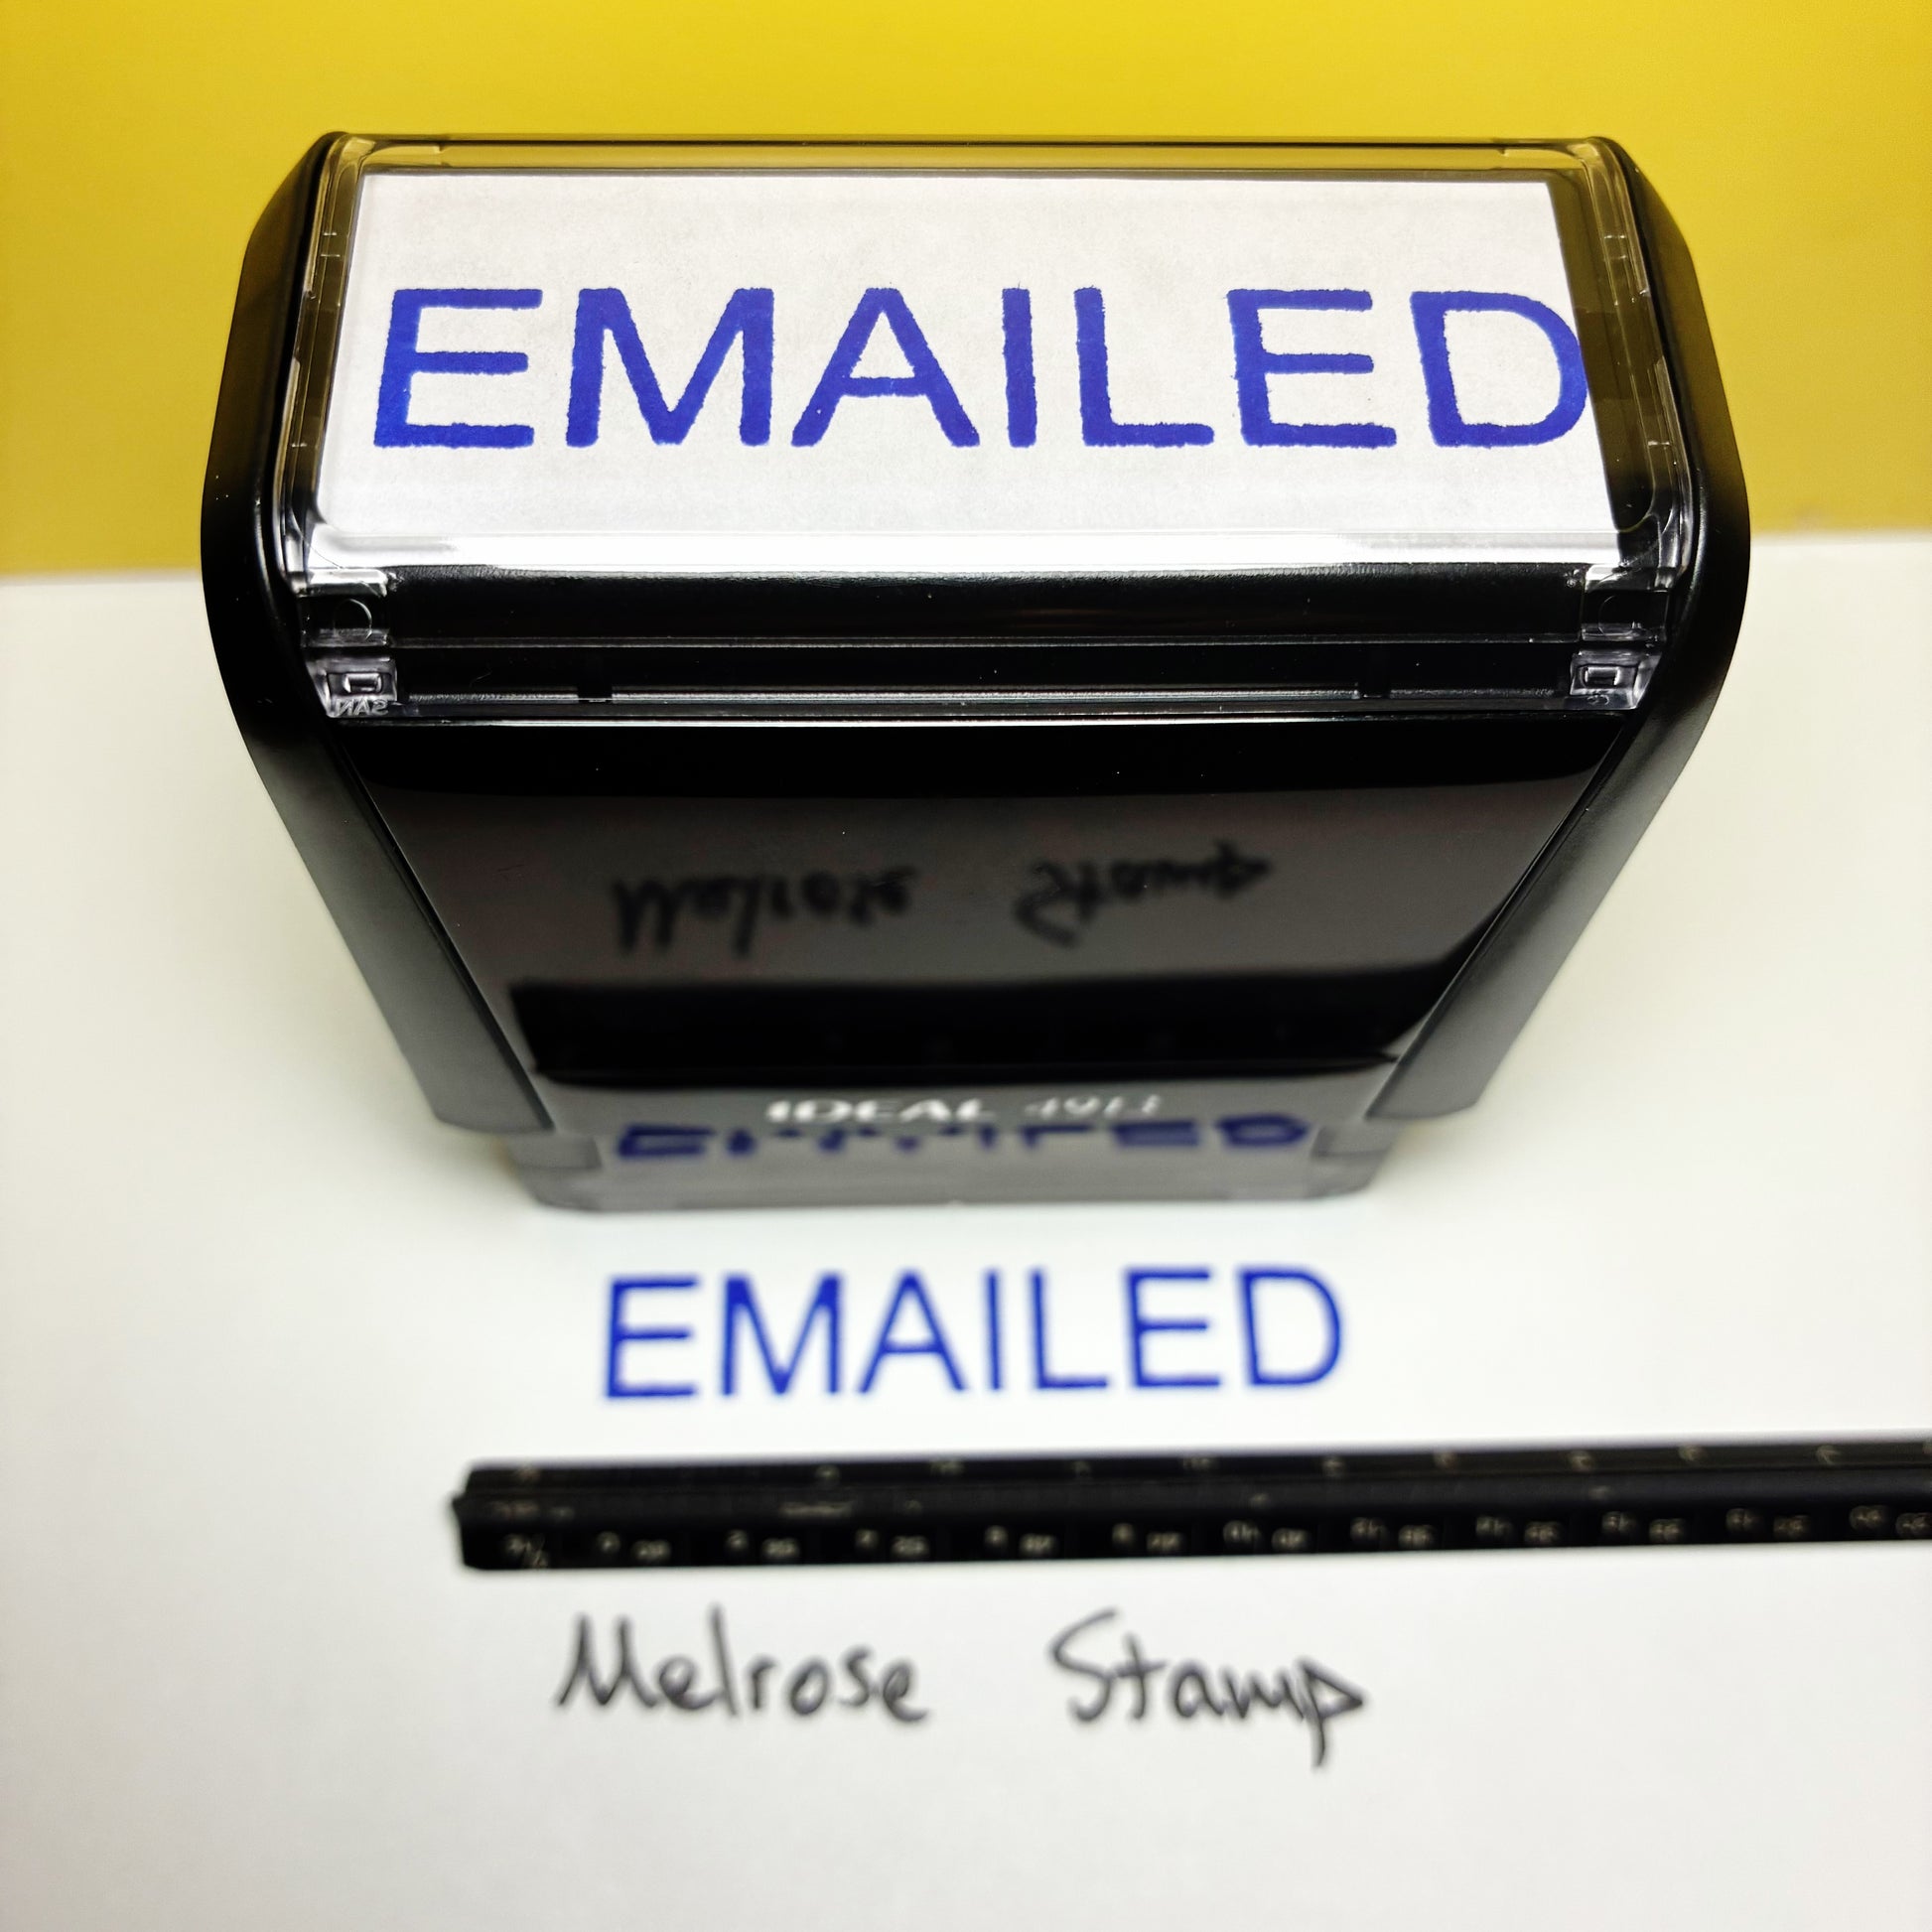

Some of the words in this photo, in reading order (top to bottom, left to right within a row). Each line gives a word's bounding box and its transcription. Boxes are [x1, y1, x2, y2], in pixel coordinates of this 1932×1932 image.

[373, 286, 1589, 448] EMAILED
[765, 1098, 998, 1123] IDEAL
[603, 1265, 1344, 1400] EMAILED
[555, 1603, 931, 1724] Melrose
[1048, 1608, 1367, 1768] Stamp
